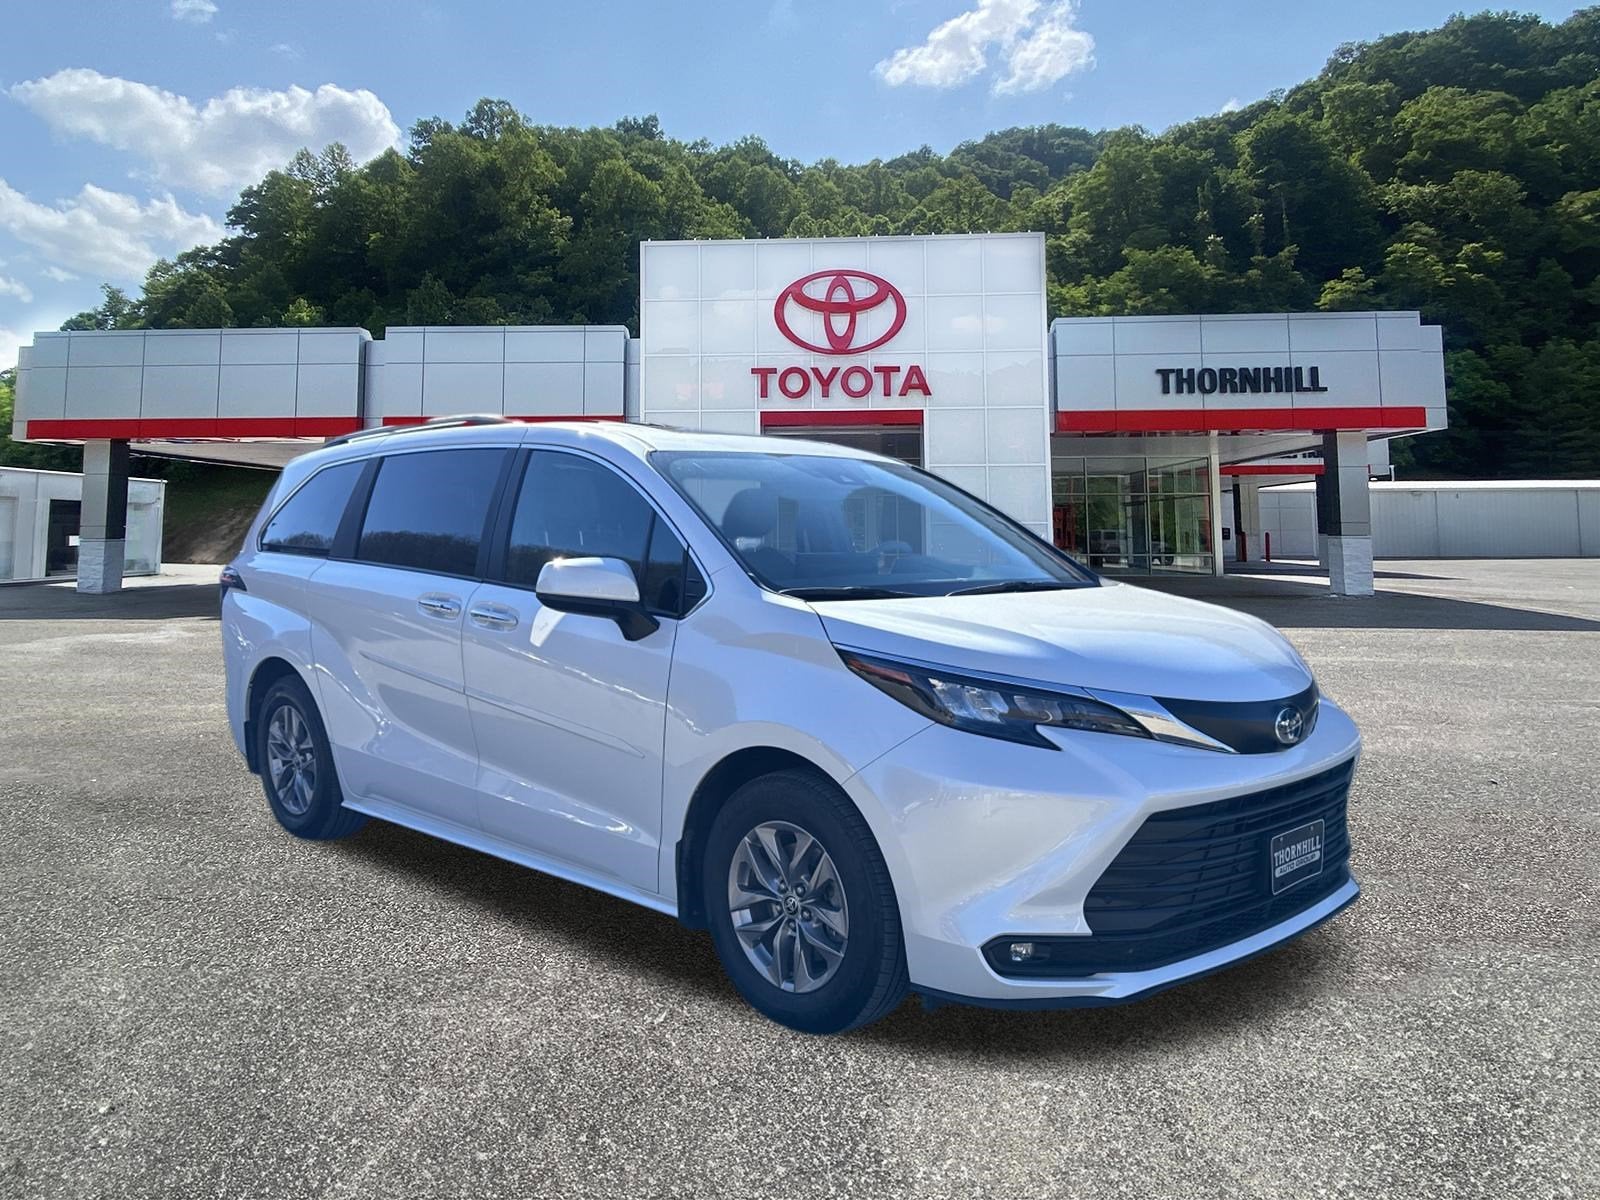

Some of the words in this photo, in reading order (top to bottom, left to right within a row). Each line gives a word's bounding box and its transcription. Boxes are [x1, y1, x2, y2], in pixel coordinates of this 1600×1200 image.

[750, 365, 932, 399] TOYOTA
[1155, 366, 1328, 394] THORNHILL
[1274, 835, 1321, 867] THORNHILL
[1279, 862, 1295, 874] AUTO
